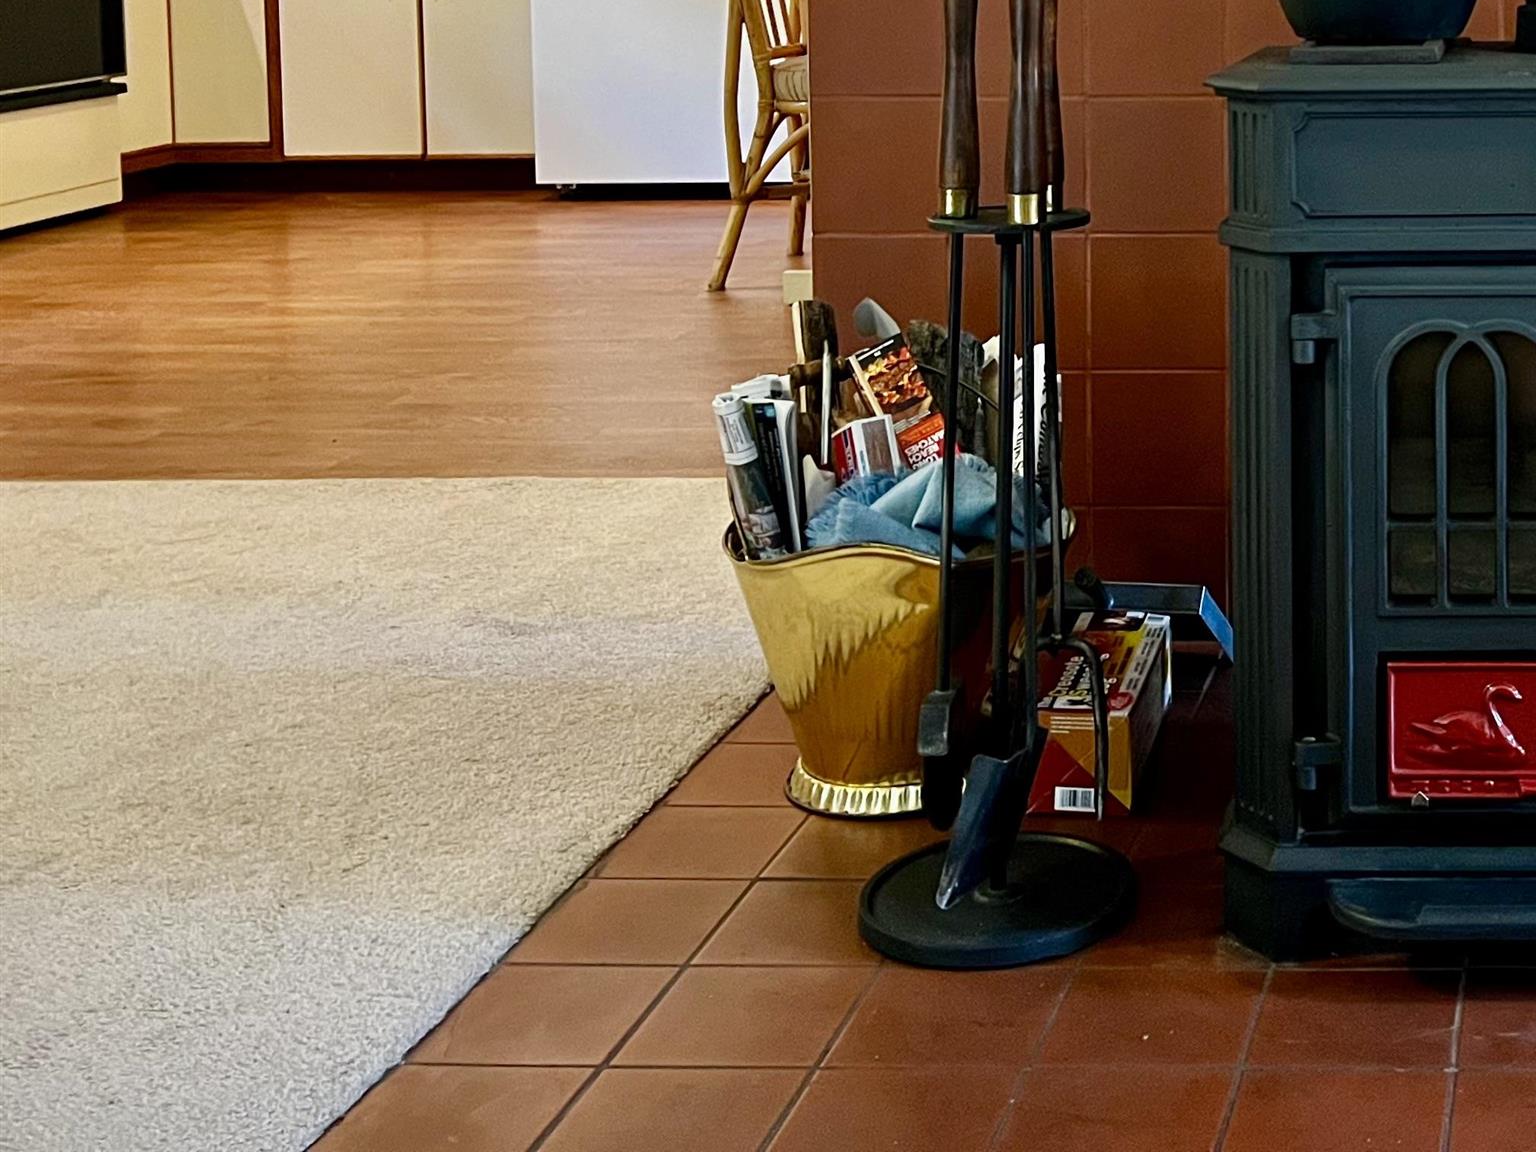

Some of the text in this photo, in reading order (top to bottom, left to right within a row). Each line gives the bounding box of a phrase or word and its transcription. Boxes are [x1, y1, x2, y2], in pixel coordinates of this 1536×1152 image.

[904, 429, 945, 457] MATCHES
[908, 443, 940, 465] REACH
[1048, 655, 1085, 697] Creosote
